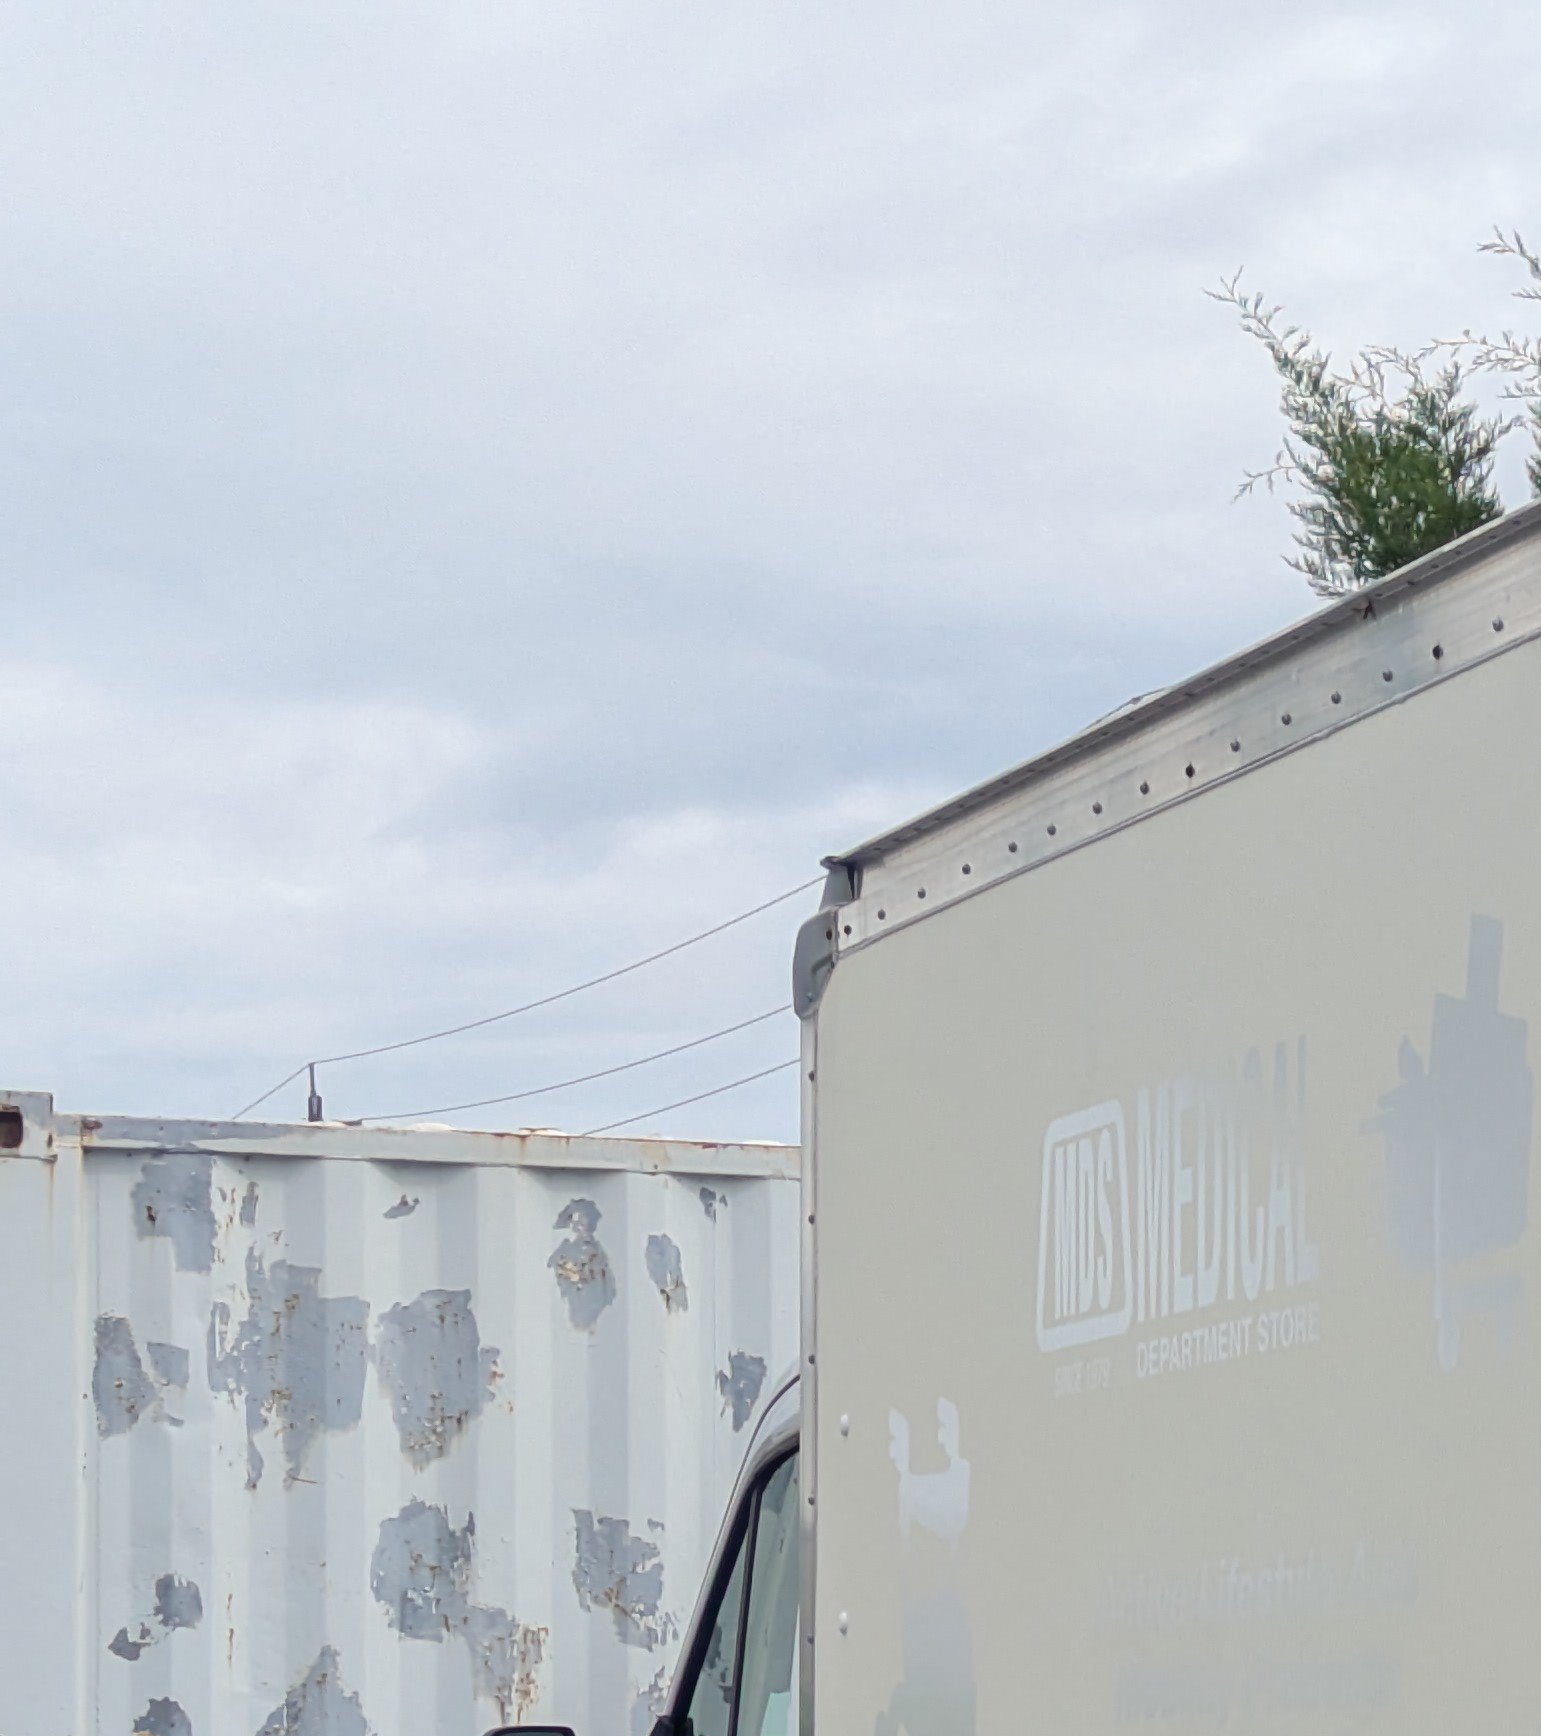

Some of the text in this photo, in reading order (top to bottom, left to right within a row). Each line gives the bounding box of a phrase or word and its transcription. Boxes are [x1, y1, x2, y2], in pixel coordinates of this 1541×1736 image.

[1054, 1129, 1114, 1320] MDS
[1136, 1034, 1321, 1322] MEDICAL
[1136, 1302, 1320, 1378] DEPARTMENT STORE
